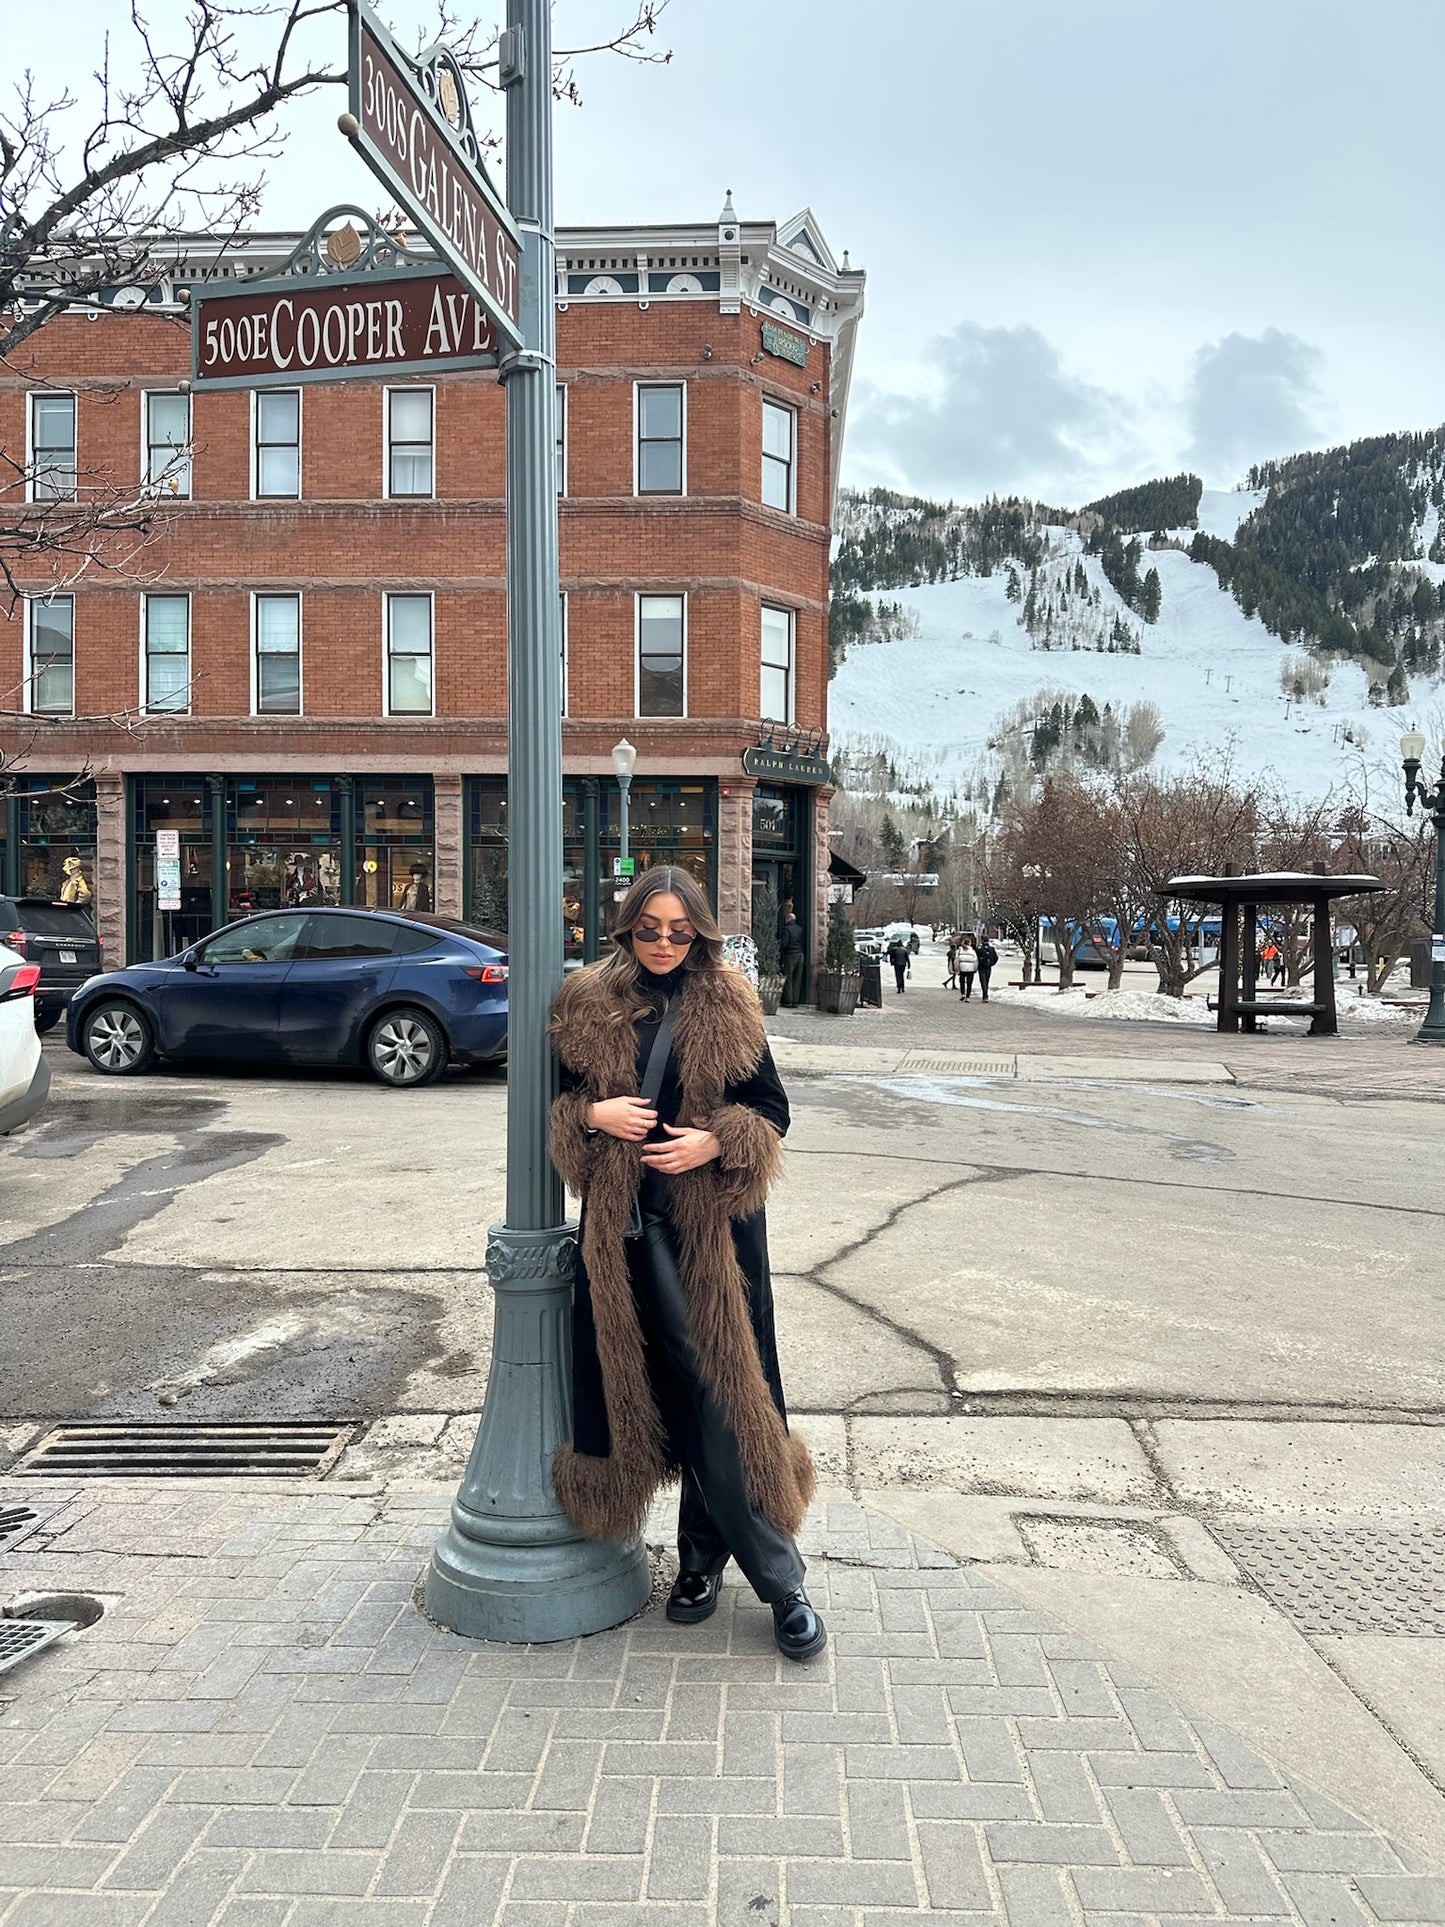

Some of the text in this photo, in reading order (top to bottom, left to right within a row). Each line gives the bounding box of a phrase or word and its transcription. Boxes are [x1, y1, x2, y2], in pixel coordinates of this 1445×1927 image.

[410, 110, 489, 287] GALENA
[496, 233, 516, 320] ST
[271, 299, 406, 369] COOPER
[423, 284, 490, 355] AVE
[754, 757, 823, 774] RALPH LAUREN
[760, 818, 775, 831] 501
